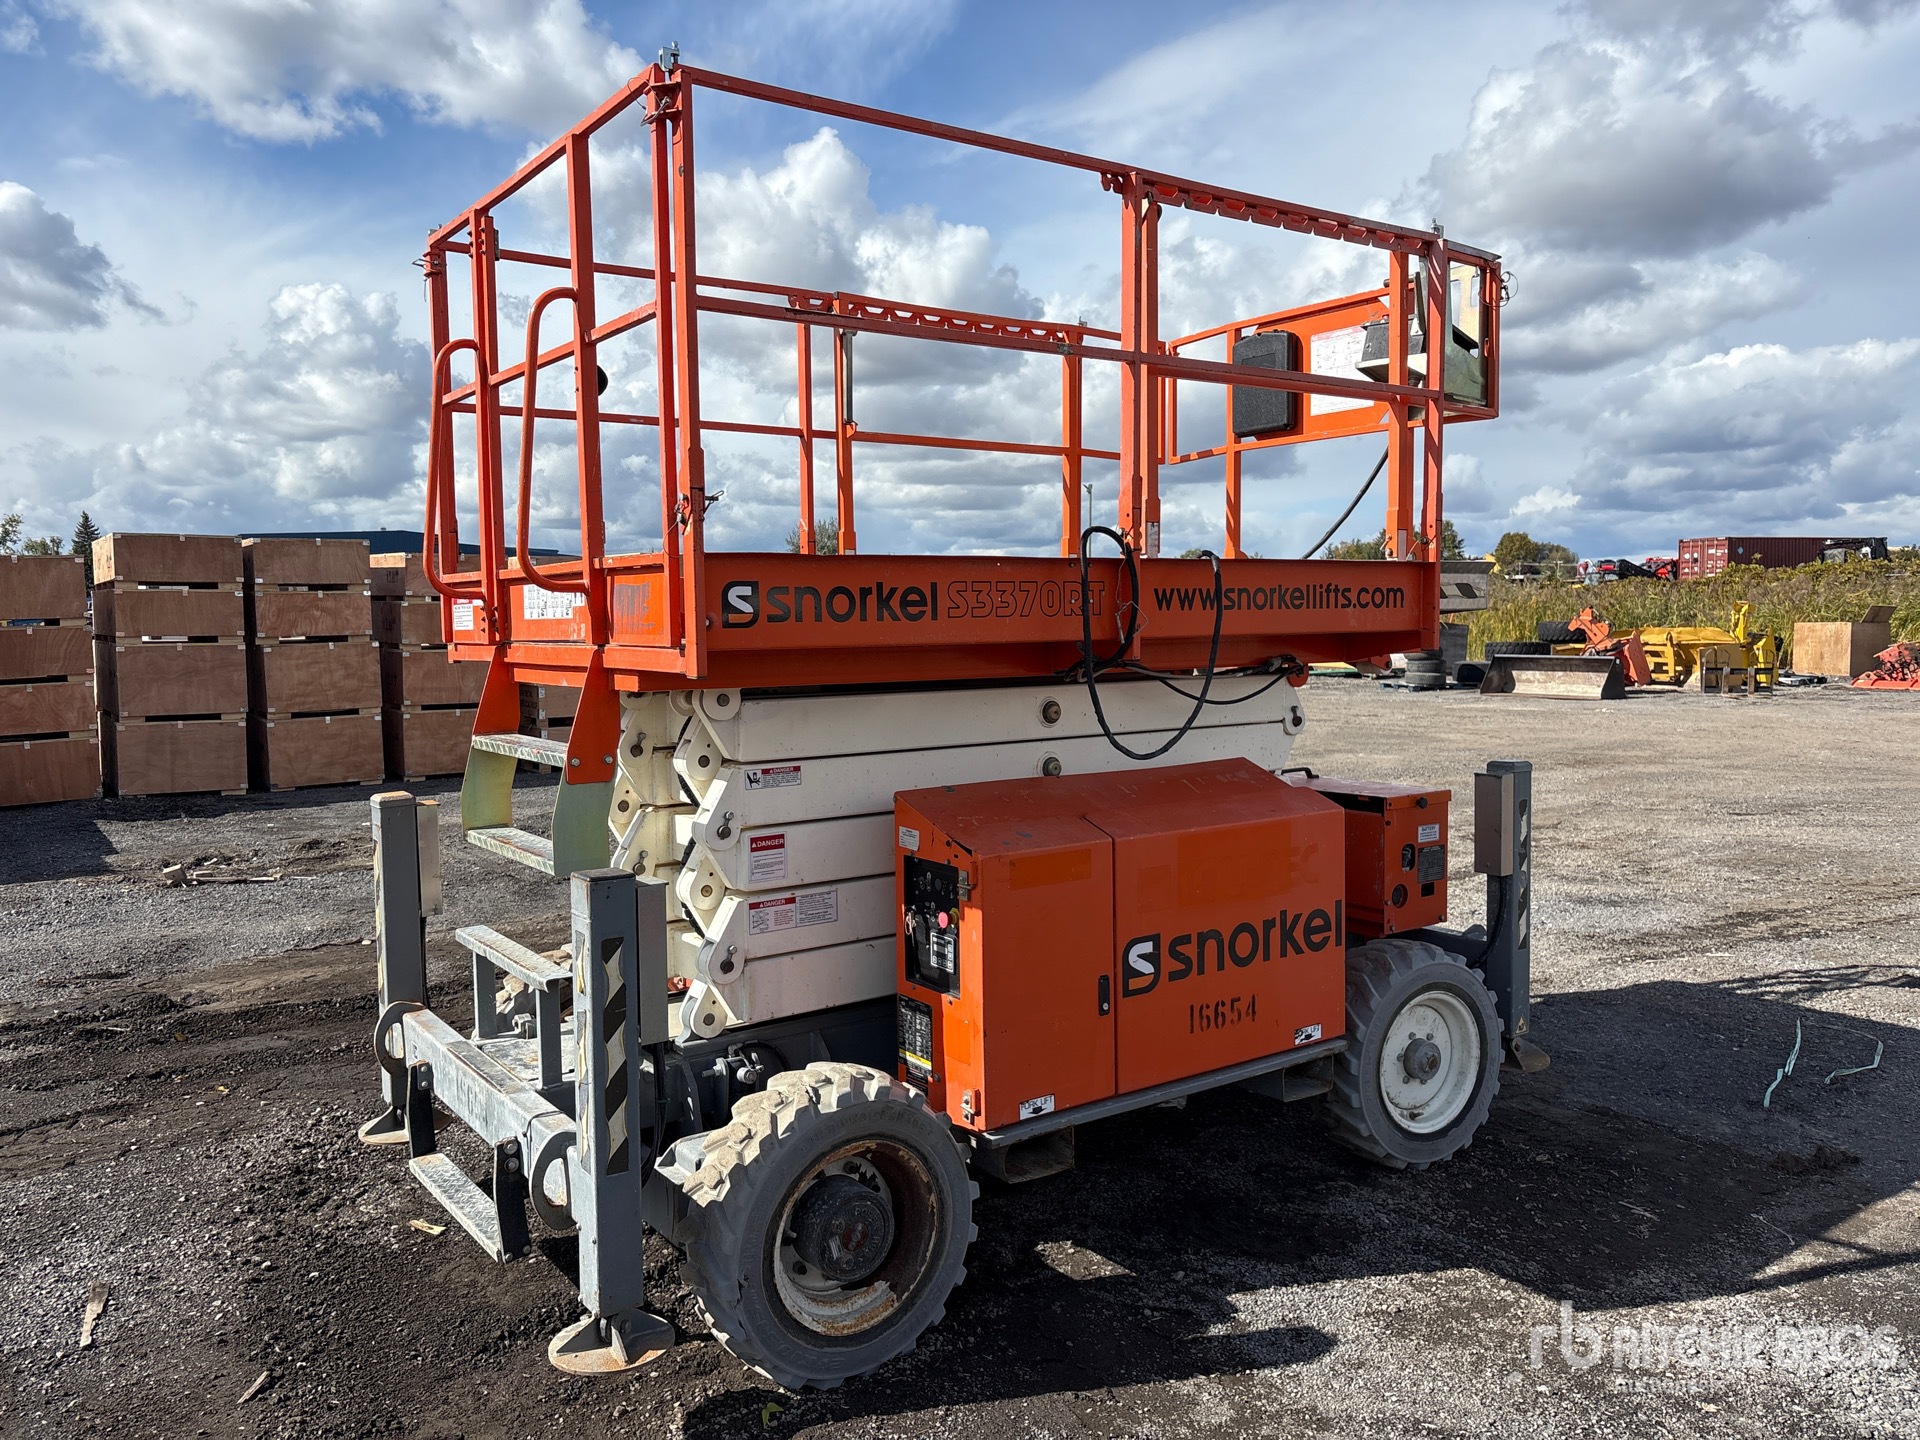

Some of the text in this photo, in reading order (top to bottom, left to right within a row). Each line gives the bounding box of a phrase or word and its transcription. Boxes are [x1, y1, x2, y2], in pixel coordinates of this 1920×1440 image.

[766, 581, 938, 623] snorkel
[947, 580, 1105, 618] S3370RT
[1153, 583, 1404, 611] wwwsnorkellifts.com
[756, 838, 784, 848] DANGER
[763, 899, 786, 907] DANGER
[1168, 899, 1342, 982] snorkel
[1189, 994, 1257, 1034] 16654
[1041, 1096, 1052, 1105] LIFT
